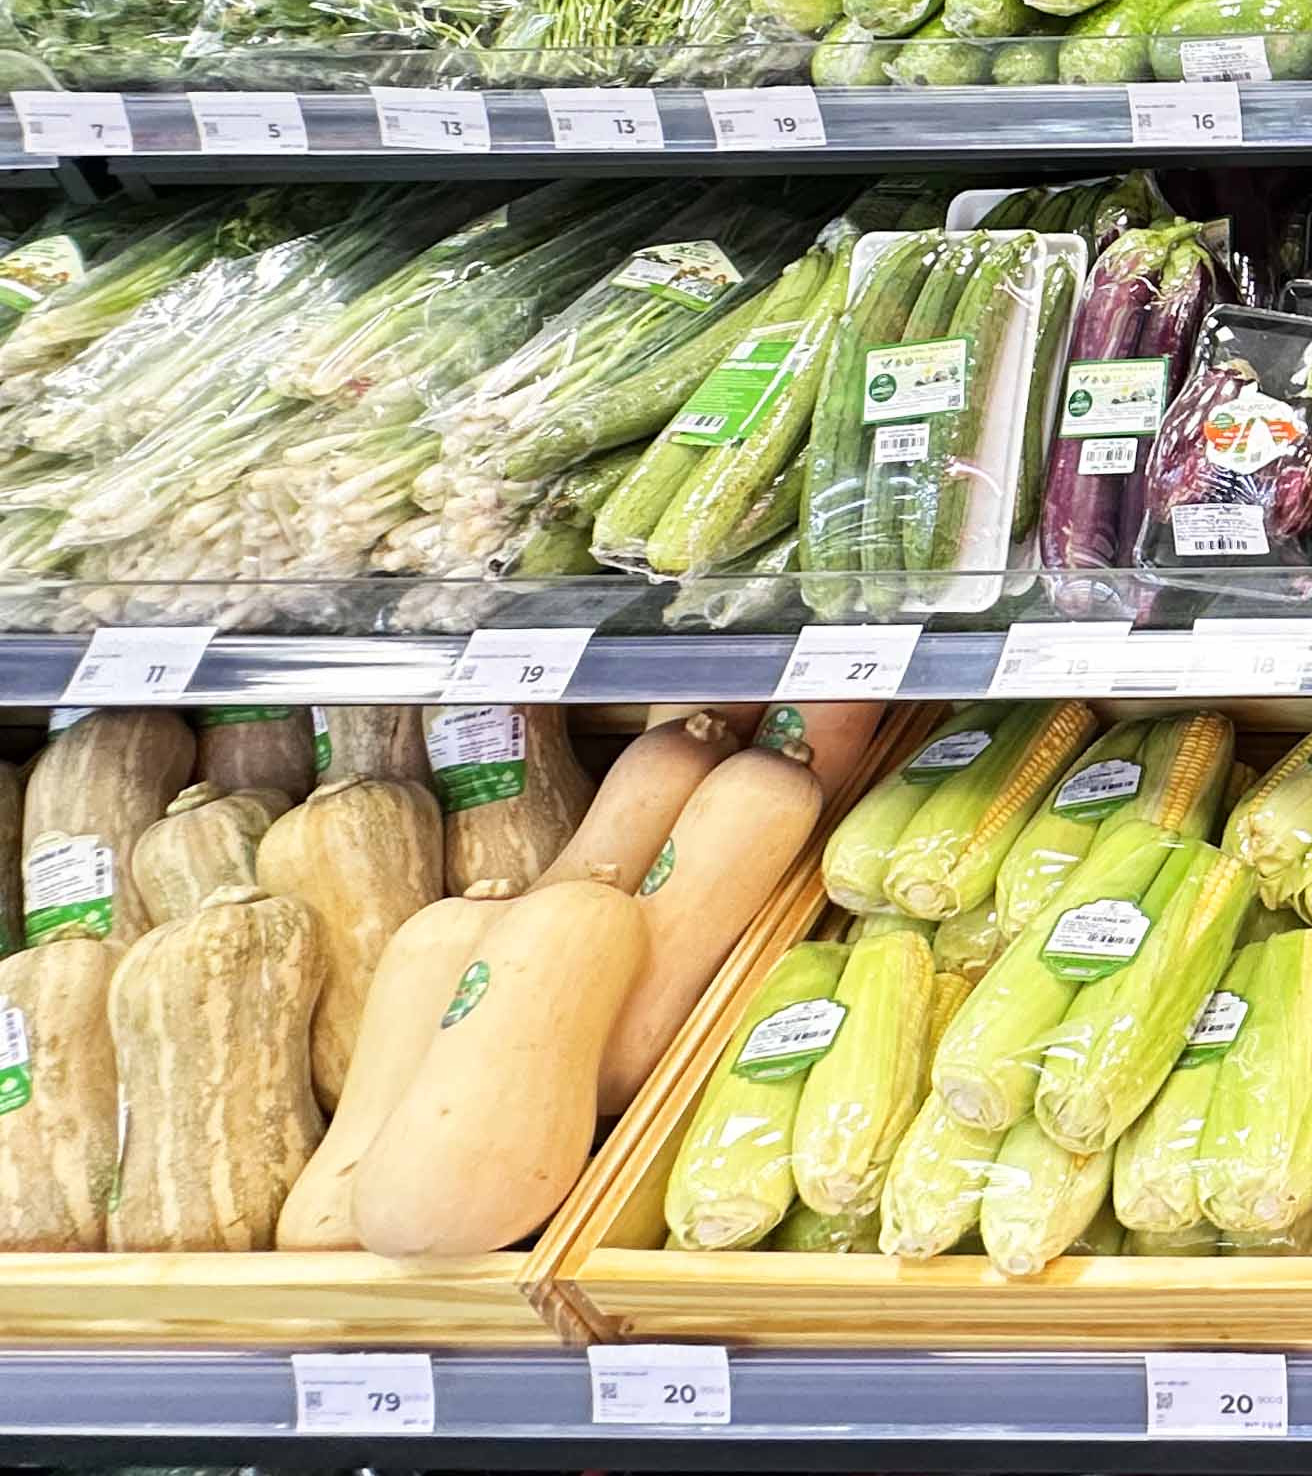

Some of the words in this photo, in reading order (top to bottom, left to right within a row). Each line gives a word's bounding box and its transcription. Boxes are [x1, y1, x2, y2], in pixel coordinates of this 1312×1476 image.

[440, 120, 463, 137] 13
[612, 119, 636, 135] 13
[773, 117, 797, 133] 19
[1191, 113, 1215, 130] 16
[90, 123, 105, 139] 7
[267, 123, 281, 139] 5
[145, 664, 167, 684] 11
[519, 665, 545, 684] 19
[845, 662, 879, 680] 27
[367, 1392, 401, 1412] 79
[663, 1384, 697, 1404] 20
[1220, 1394, 1254, 1415] 20
